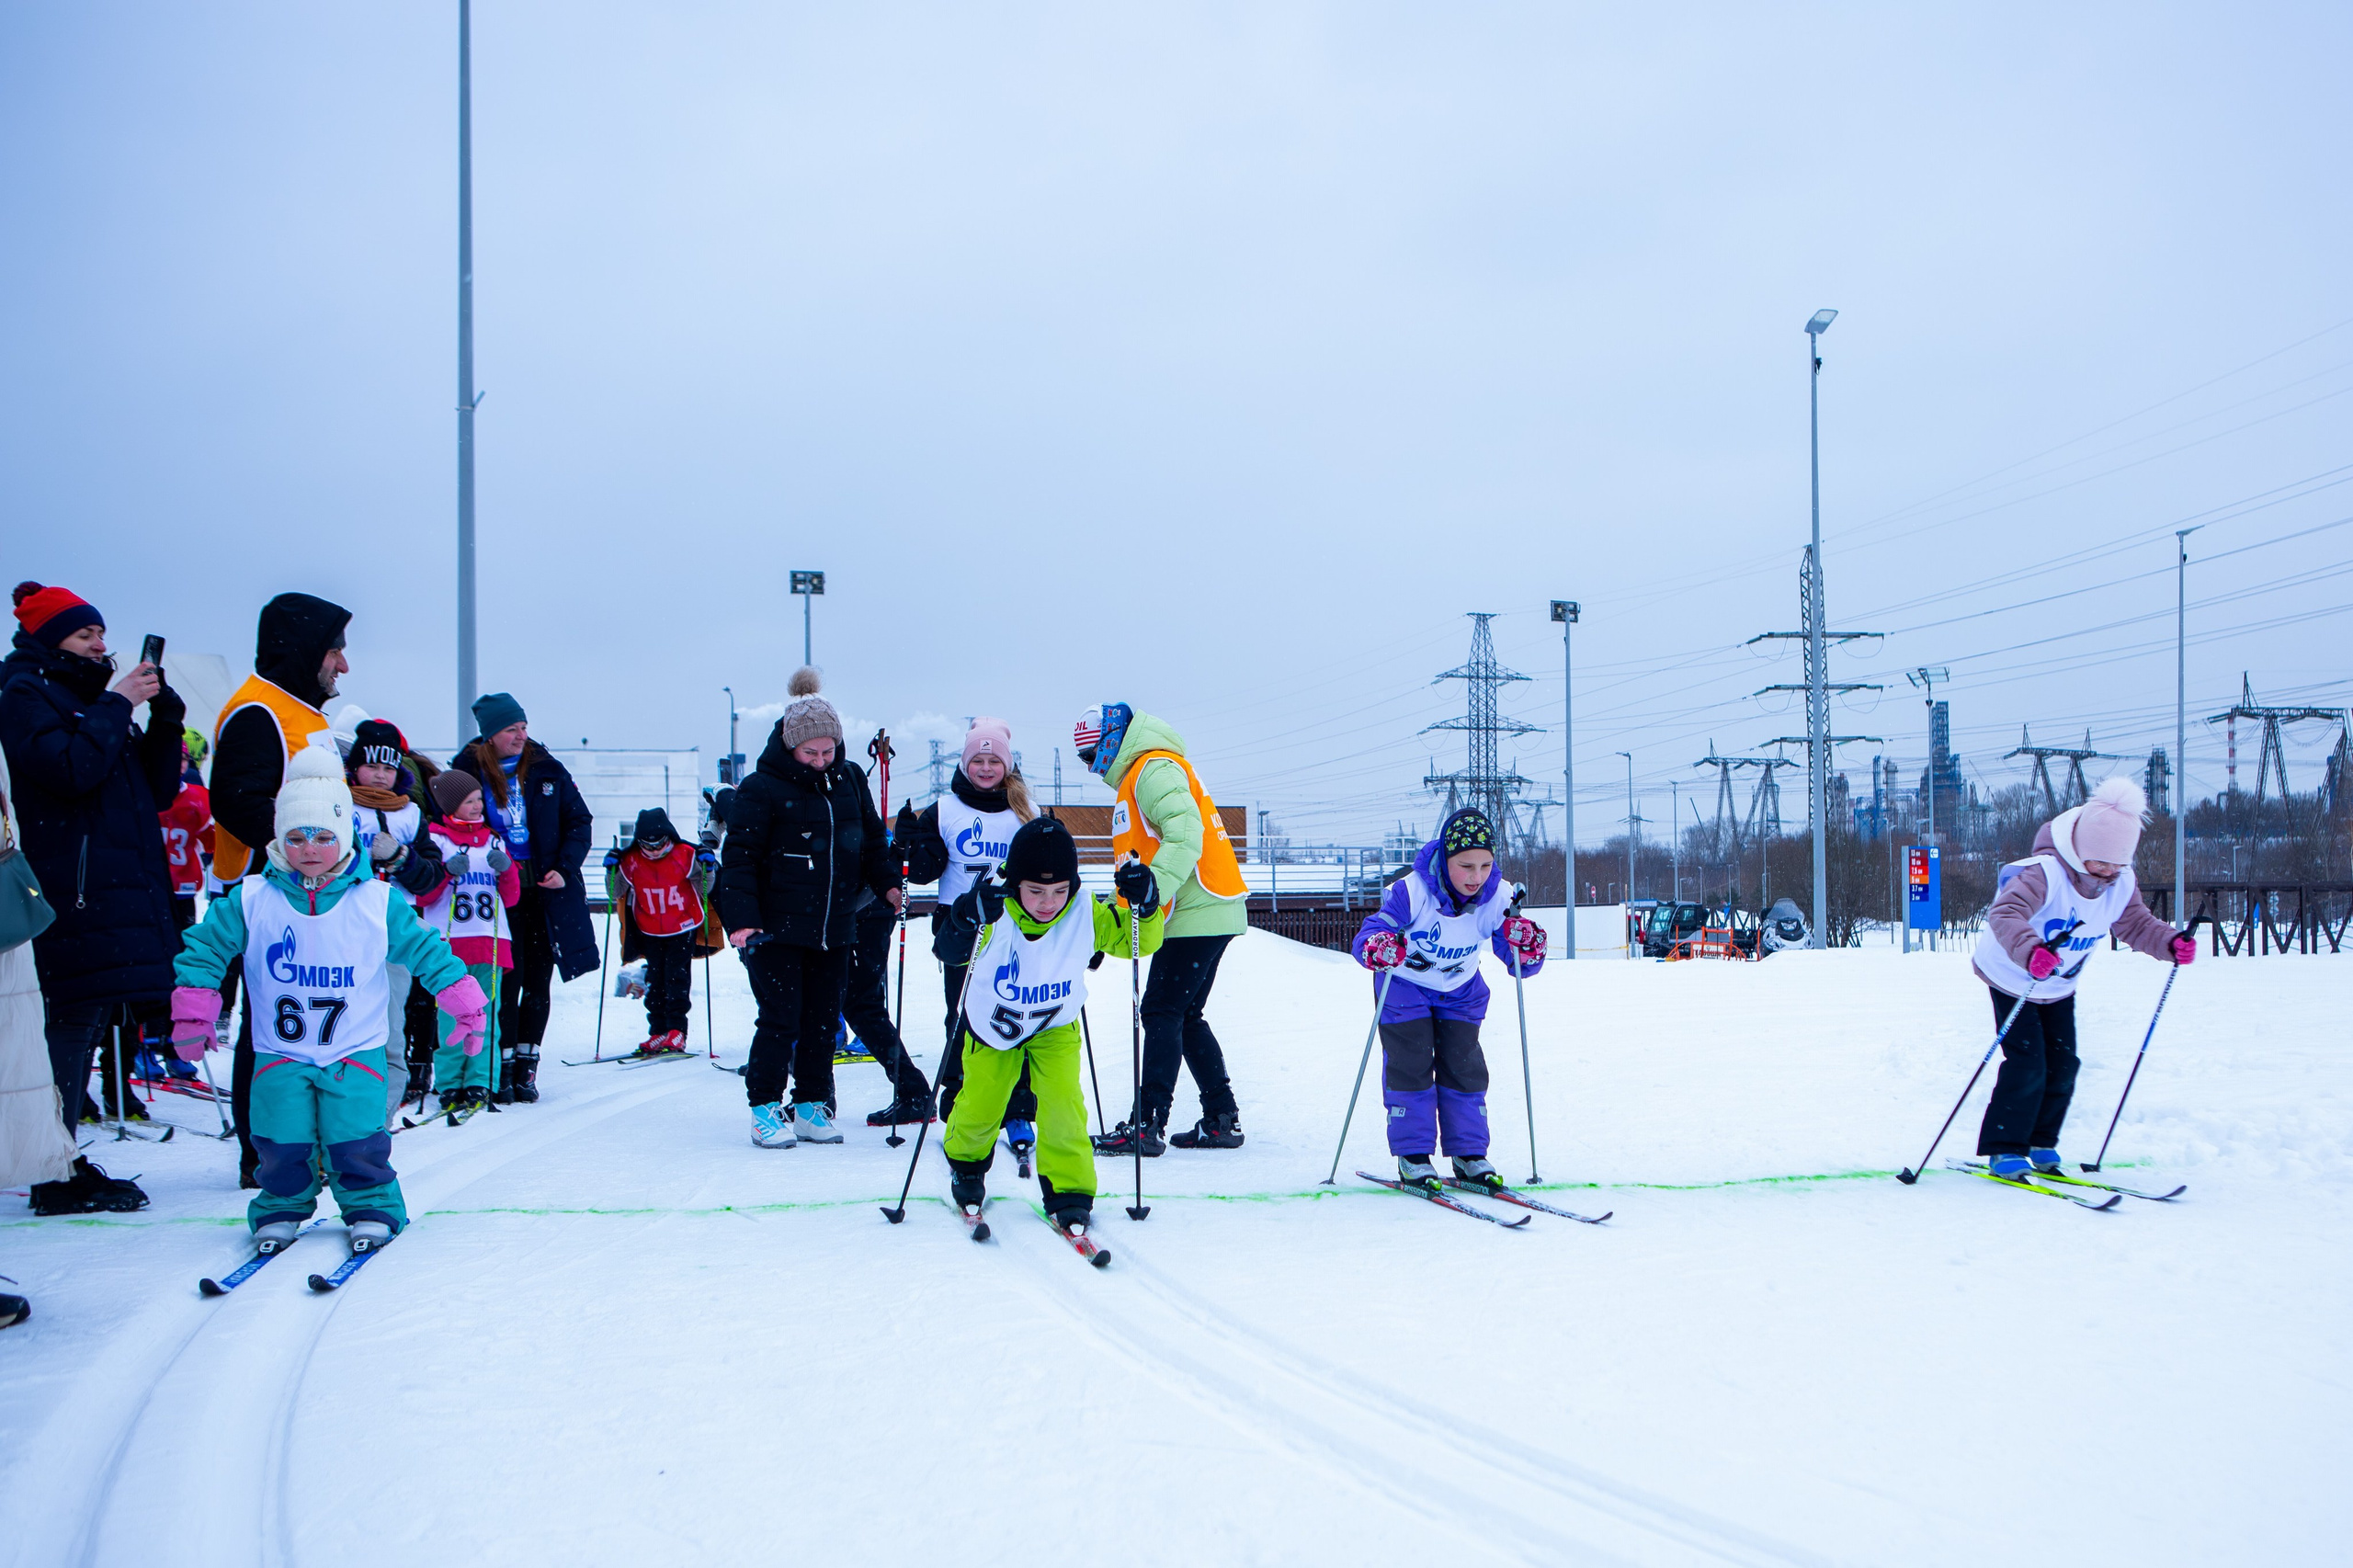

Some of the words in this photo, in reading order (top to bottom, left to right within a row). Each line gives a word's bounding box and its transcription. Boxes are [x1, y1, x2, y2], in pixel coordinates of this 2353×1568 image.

[985, 842, 1008, 858] МО
[964, 862, 993, 889] 7
[452, 891, 494, 923] 68
[642, 885, 685, 915] 174
[299, 964, 355, 989] МОЭК
[1021, 980, 1072, 1005] МОЭК
[273, 994, 349, 1046] 67
[989, 1003, 1064, 1041] 57
[1461, 1181, 1490, 1196] ROSSIGNOL
